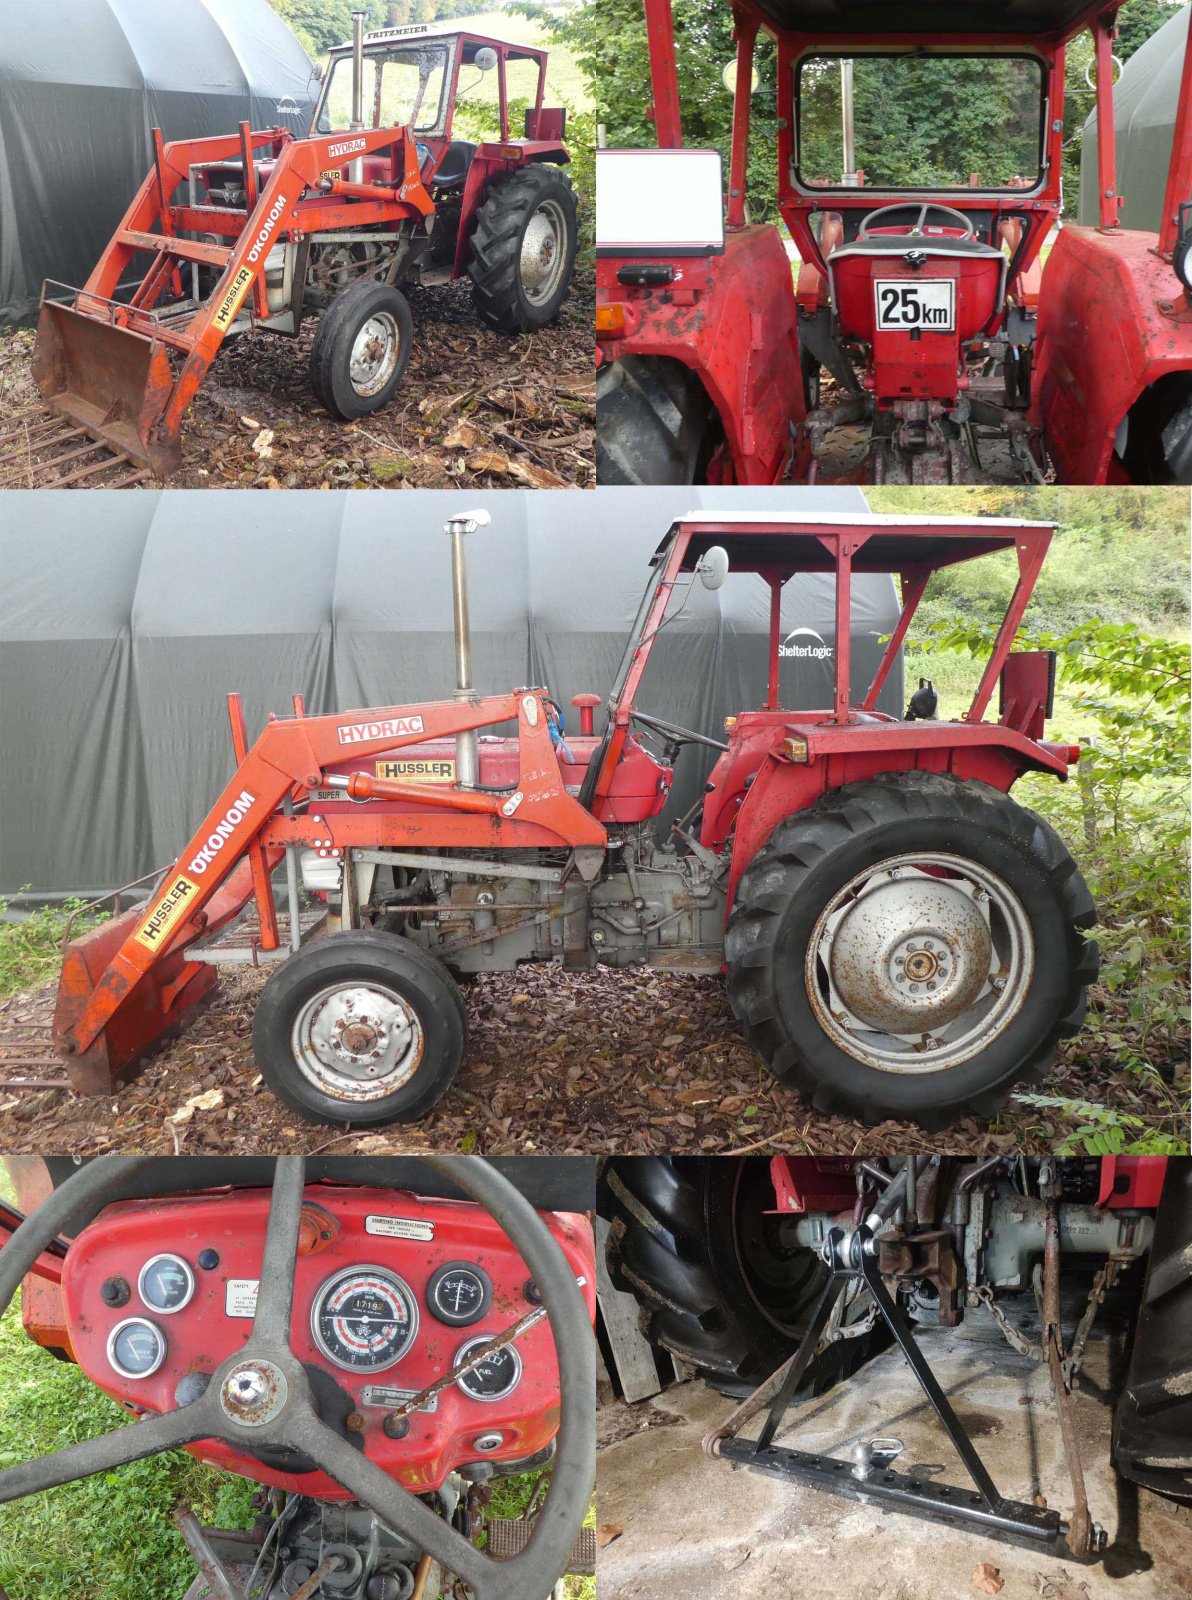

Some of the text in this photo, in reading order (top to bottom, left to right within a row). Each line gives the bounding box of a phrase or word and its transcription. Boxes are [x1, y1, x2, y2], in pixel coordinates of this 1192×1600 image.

[367, 25, 428, 39] FRITZMEIER
[329, 139, 366, 156] HYDRAC
[320, 171, 340, 180] SSLER
[217, 269, 250, 322] HUSSLER
[778, 644, 832, 659] ShelterLogic
[340, 717, 422, 743] HYDRAC
[385, 763, 452, 777] HUSSLER
[318, 790, 340, 799] SUPER
[143, 879, 192, 940] HUSSLER
